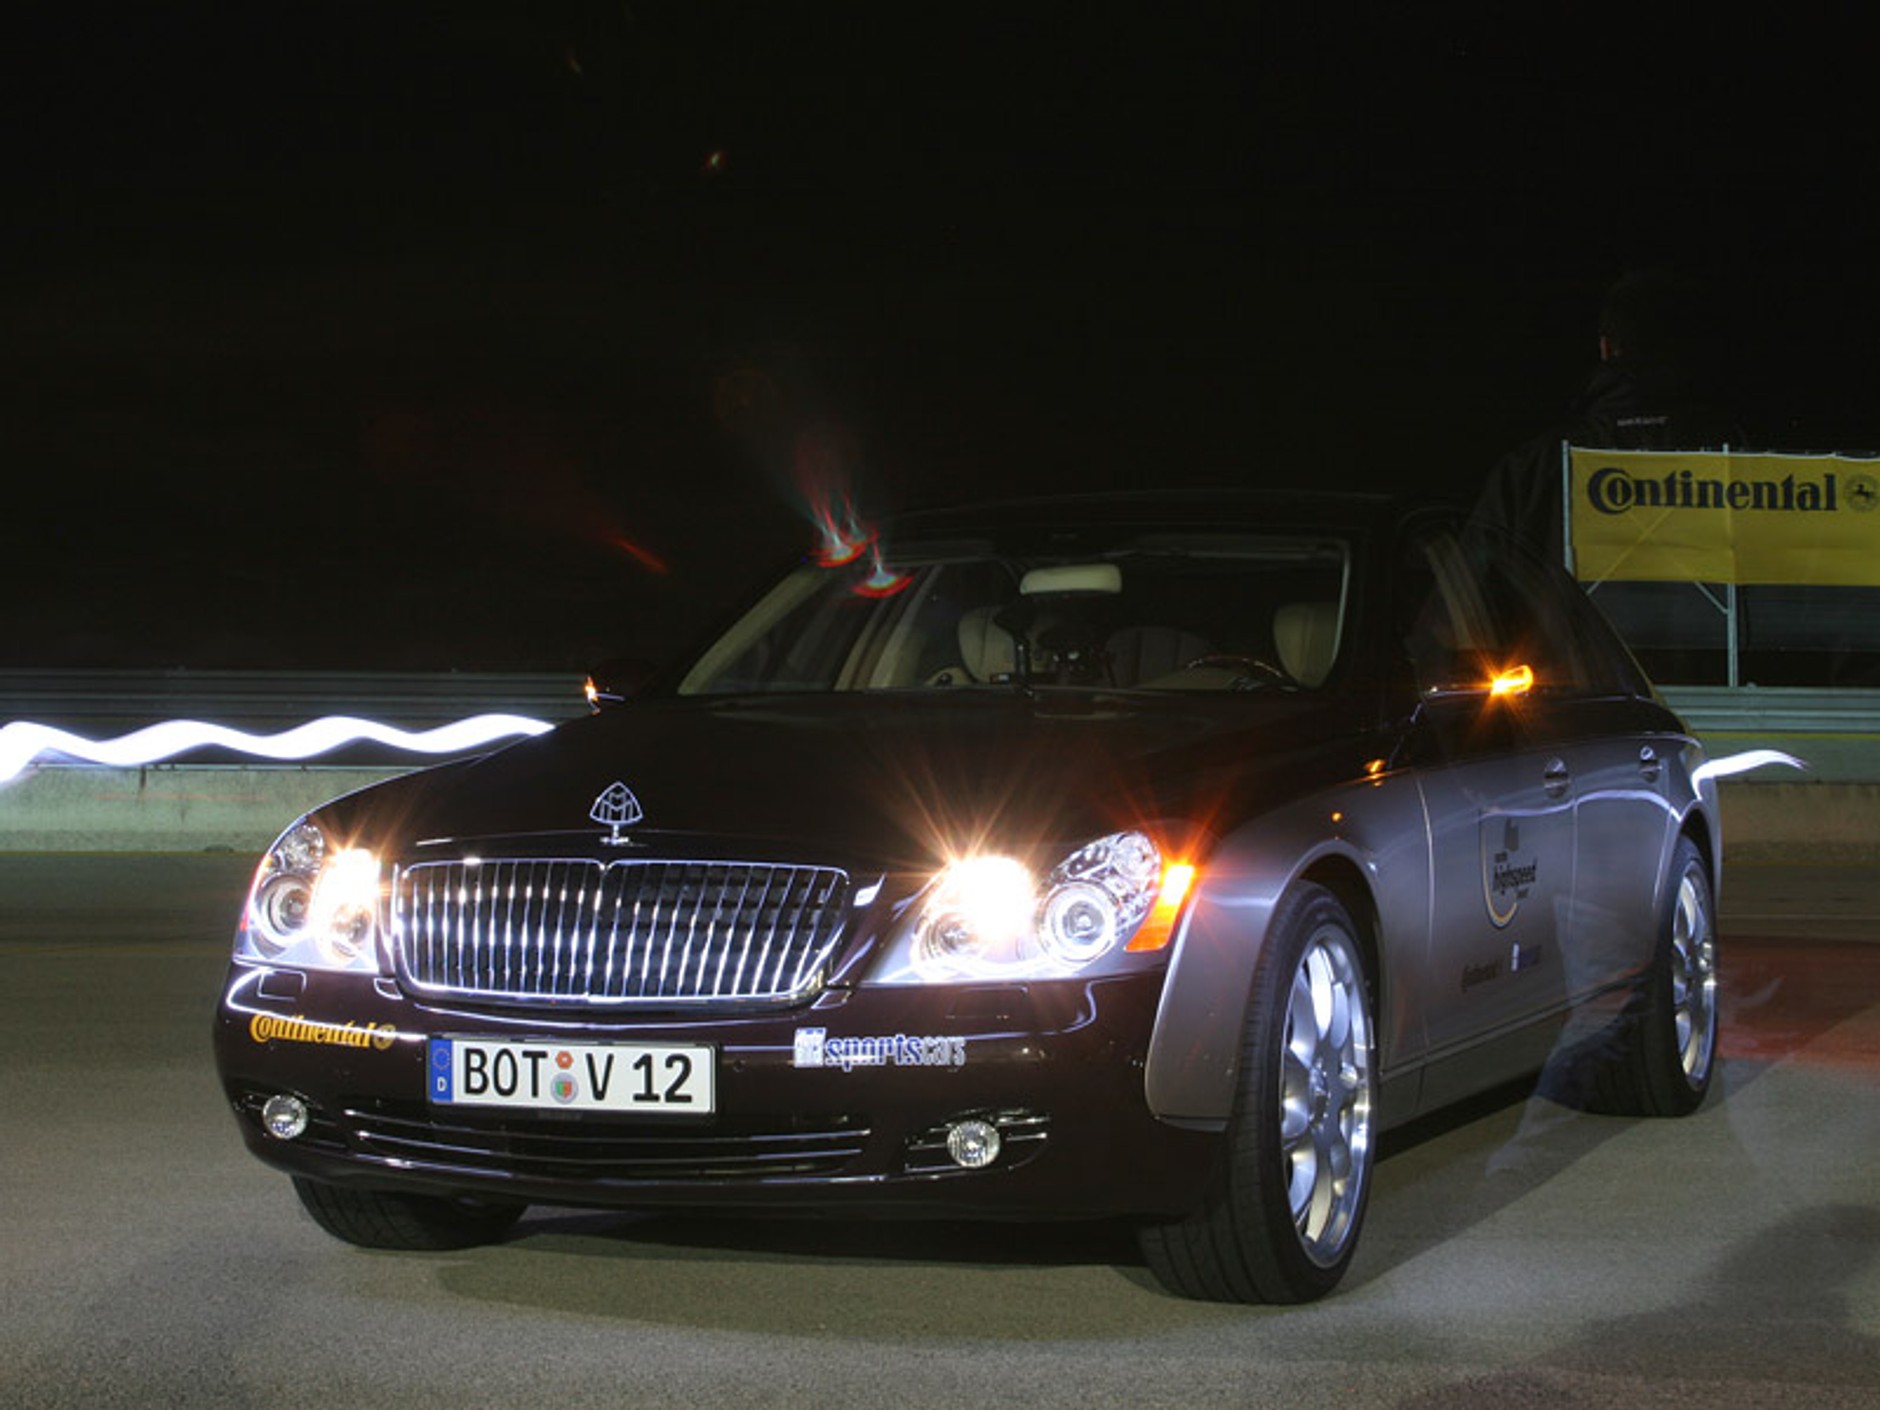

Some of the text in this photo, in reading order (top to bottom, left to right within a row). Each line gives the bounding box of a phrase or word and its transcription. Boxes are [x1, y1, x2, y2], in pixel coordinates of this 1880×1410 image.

[1587, 467, 1838, 515] Continental
[250, 1014, 376, 1048] Continental
[463, 1048, 694, 1103] BOT V 12
